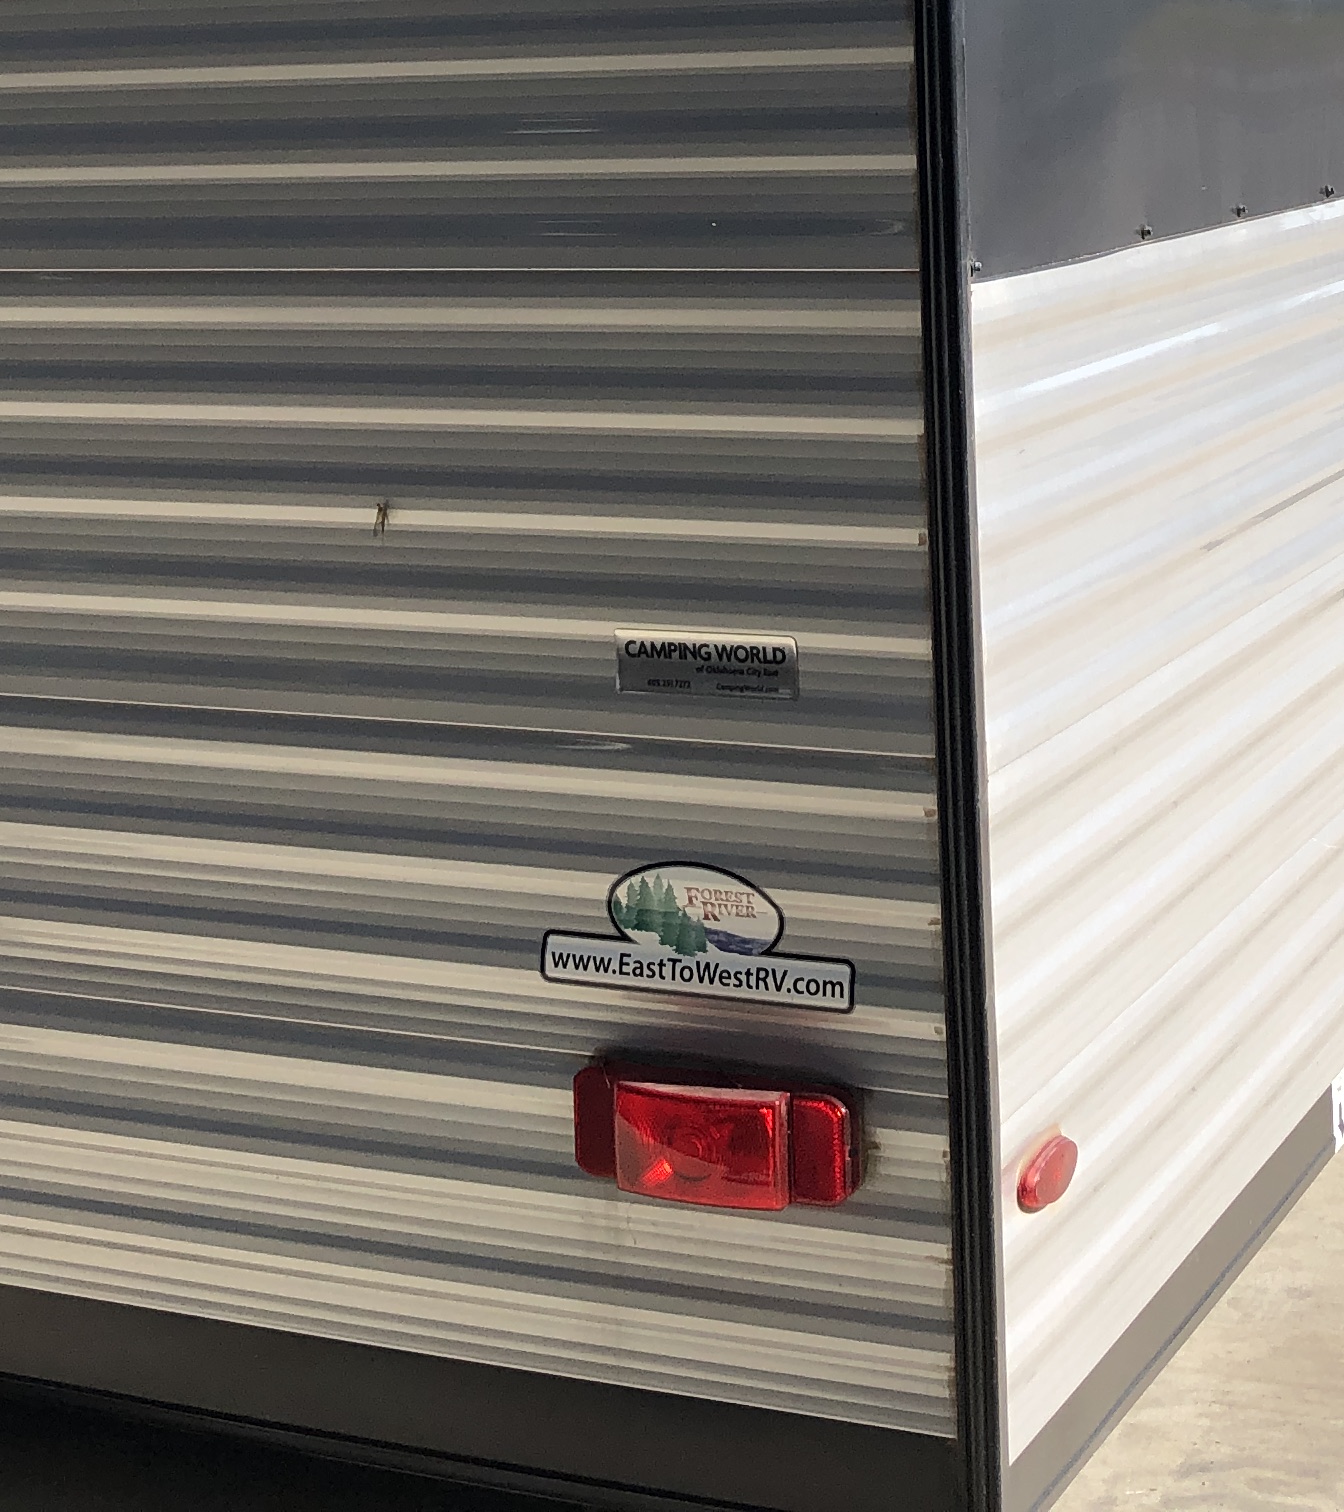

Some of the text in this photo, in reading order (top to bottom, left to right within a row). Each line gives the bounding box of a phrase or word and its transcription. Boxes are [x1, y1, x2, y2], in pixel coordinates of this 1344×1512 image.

[624, 639, 787, 665] CAMPING WORLD
[684, 886, 755, 908] FOREST
[699, 900, 759, 923] RIVER
[550, 950, 846, 999] www.EastToWestRV.com
